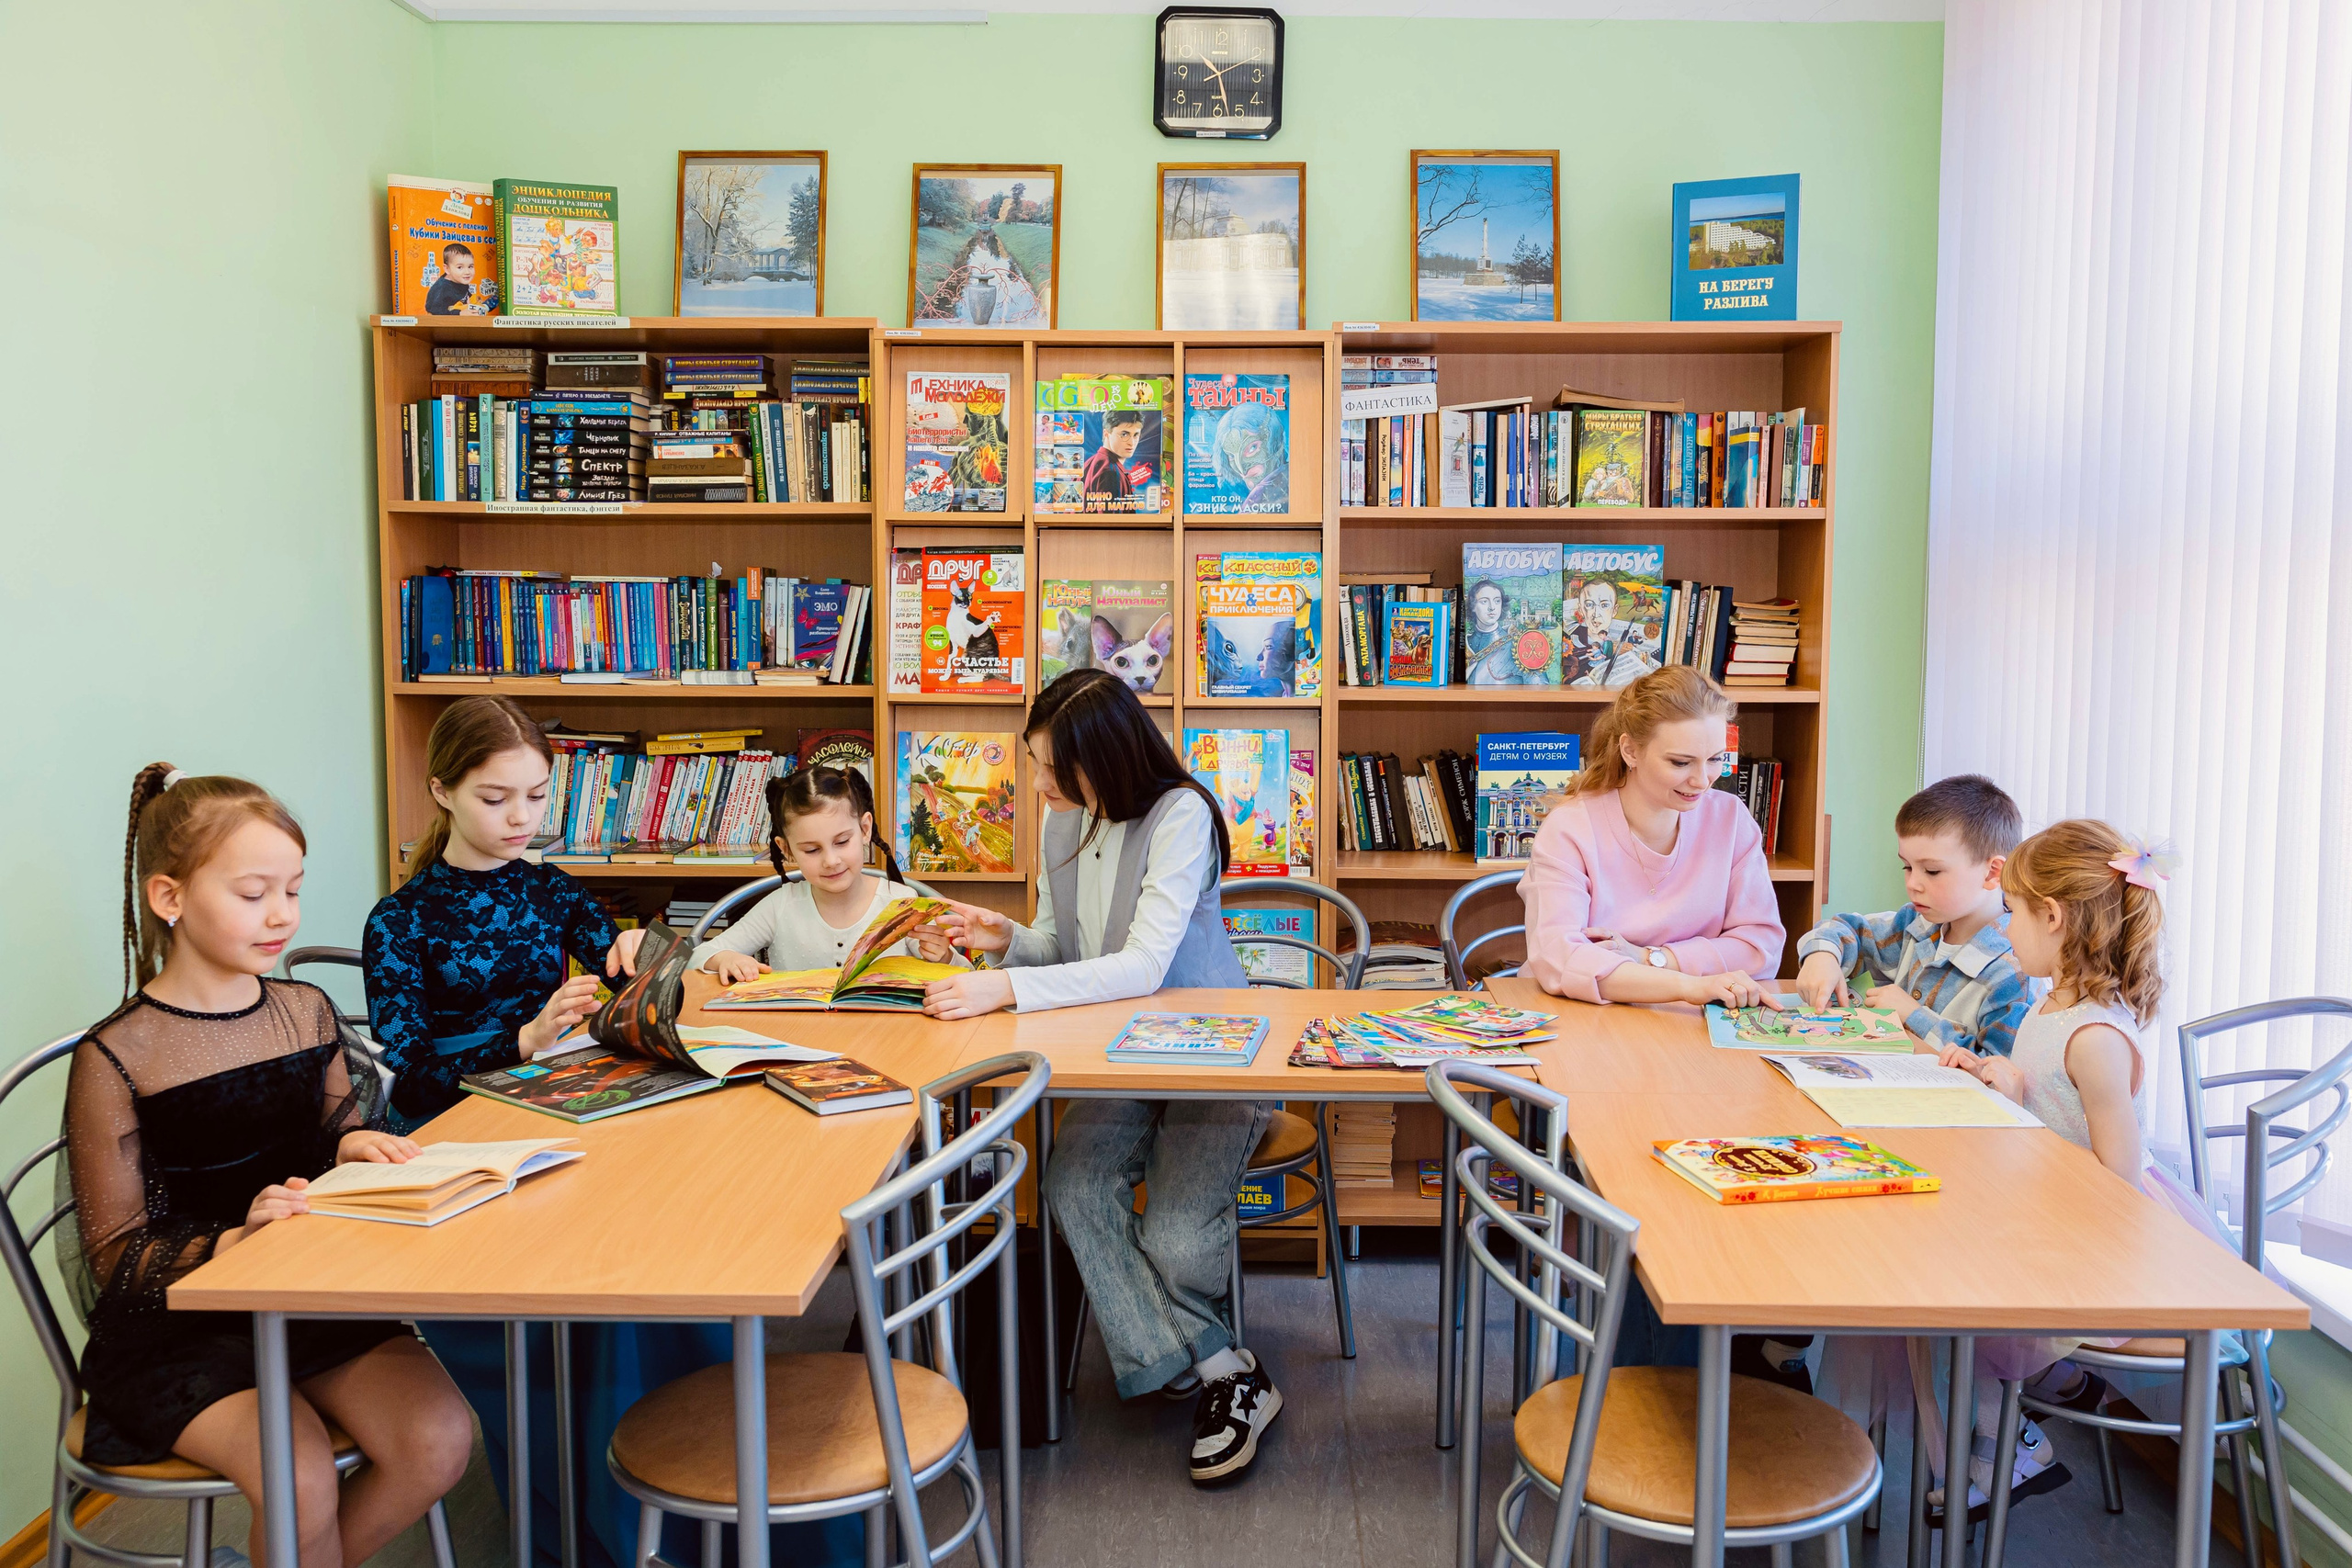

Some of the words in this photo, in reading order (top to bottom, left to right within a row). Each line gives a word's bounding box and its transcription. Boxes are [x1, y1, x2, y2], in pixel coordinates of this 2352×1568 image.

[1216, 31, 1228, 46] 12
[1251, 47, 1261, 61] 2
[1178, 65, 1188, 80] 9
[1252, 69, 1261, 83] 3
[1176, 90, 1185, 104] 8
[1250, 92, 1260, 105] 4
[1193, 103, 1202, 116] 7
[1213, 104, 1223, 118] 6
[1235, 105, 1244, 118] 5
[512, 186, 612, 201] ЭНЦИКЛОПЕДИЯ
[517, 197, 557, 205] ОБУЧЕНИЯ
[513, 204, 609, 219] ДОШКОЛЬНИКА
[426, 219, 457, 228] Обучение
[463, 223, 489, 231] пеленок
[410, 227, 440, 241] Кубики
[441, 230, 476, 243] Зайцева
[1699, 281, 1718, 293] НА
[1722, 277, 1774, 292] БЕРЕГУ
[1703, 295, 1769, 310] РАЗЛИВА
[494, 318, 543, 326] Фантастика
[544, 319, 575, 327] русских
[695, 359, 720, 367] БРАТЬЕВ
[721, 358, 759, 367] СТРУГАЦКИХ
[721, 373, 759, 381] СТРУГАЦКИХ
[793, 380, 831, 389] СТРУГАЦКИХ
[1058, 386, 1109, 406] GEO
[1345, 395, 1431, 412] ФАНТАСТИКА
[908, 427, 967, 436] Биотеррористы
[1585, 422, 1642, 431] СТРУГАЦКИХ
[1086, 491, 1113, 501] КИНО
[487, 504, 538, 513] Иностранная
[540, 504, 588, 513] фантастика,
[590, 504, 620, 513] фэнтези
[1086, 502, 1106, 513] ДЛЯ
[1108, 502, 1145, 511] МАГЛОВ
[1189, 503, 1227, 514] УЗНИК
[1232, 503, 1282, 513] МАСКИ?
[1225, 560, 1301, 572] КЛАССНЫЙ
[1468, 550, 1556, 570] АВТОБУС
[1567, 551, 1659, 572] АВТОБУС
[927, 559, 984, 581] ДРУГ
[1102, 586, 1141, 597] Юный
[1210, 587, 1293, 602] ЧУДЕСА
[814, 603, 838, 611] ЭМО
[1097, 597, 1167, 609] Натуралист
[951, 657, 1009, 667] СЧАСТЬЕ
[1203, 735, 1259, 754] Винни
[1489, 752, 1520, 761] ДЕТЯМ
[1532, 752, 1567, 761] МУЗЕЯХ
[1206, 759, 1249, 769] ДРУЗЬЯ
[1452, 759, 1466, 796] СИМЕНОН
[1462, 798, 1472, 821] ЖОРЖ
[1223, 914, 1300, 931] ВЕСЁЛЫЕ
